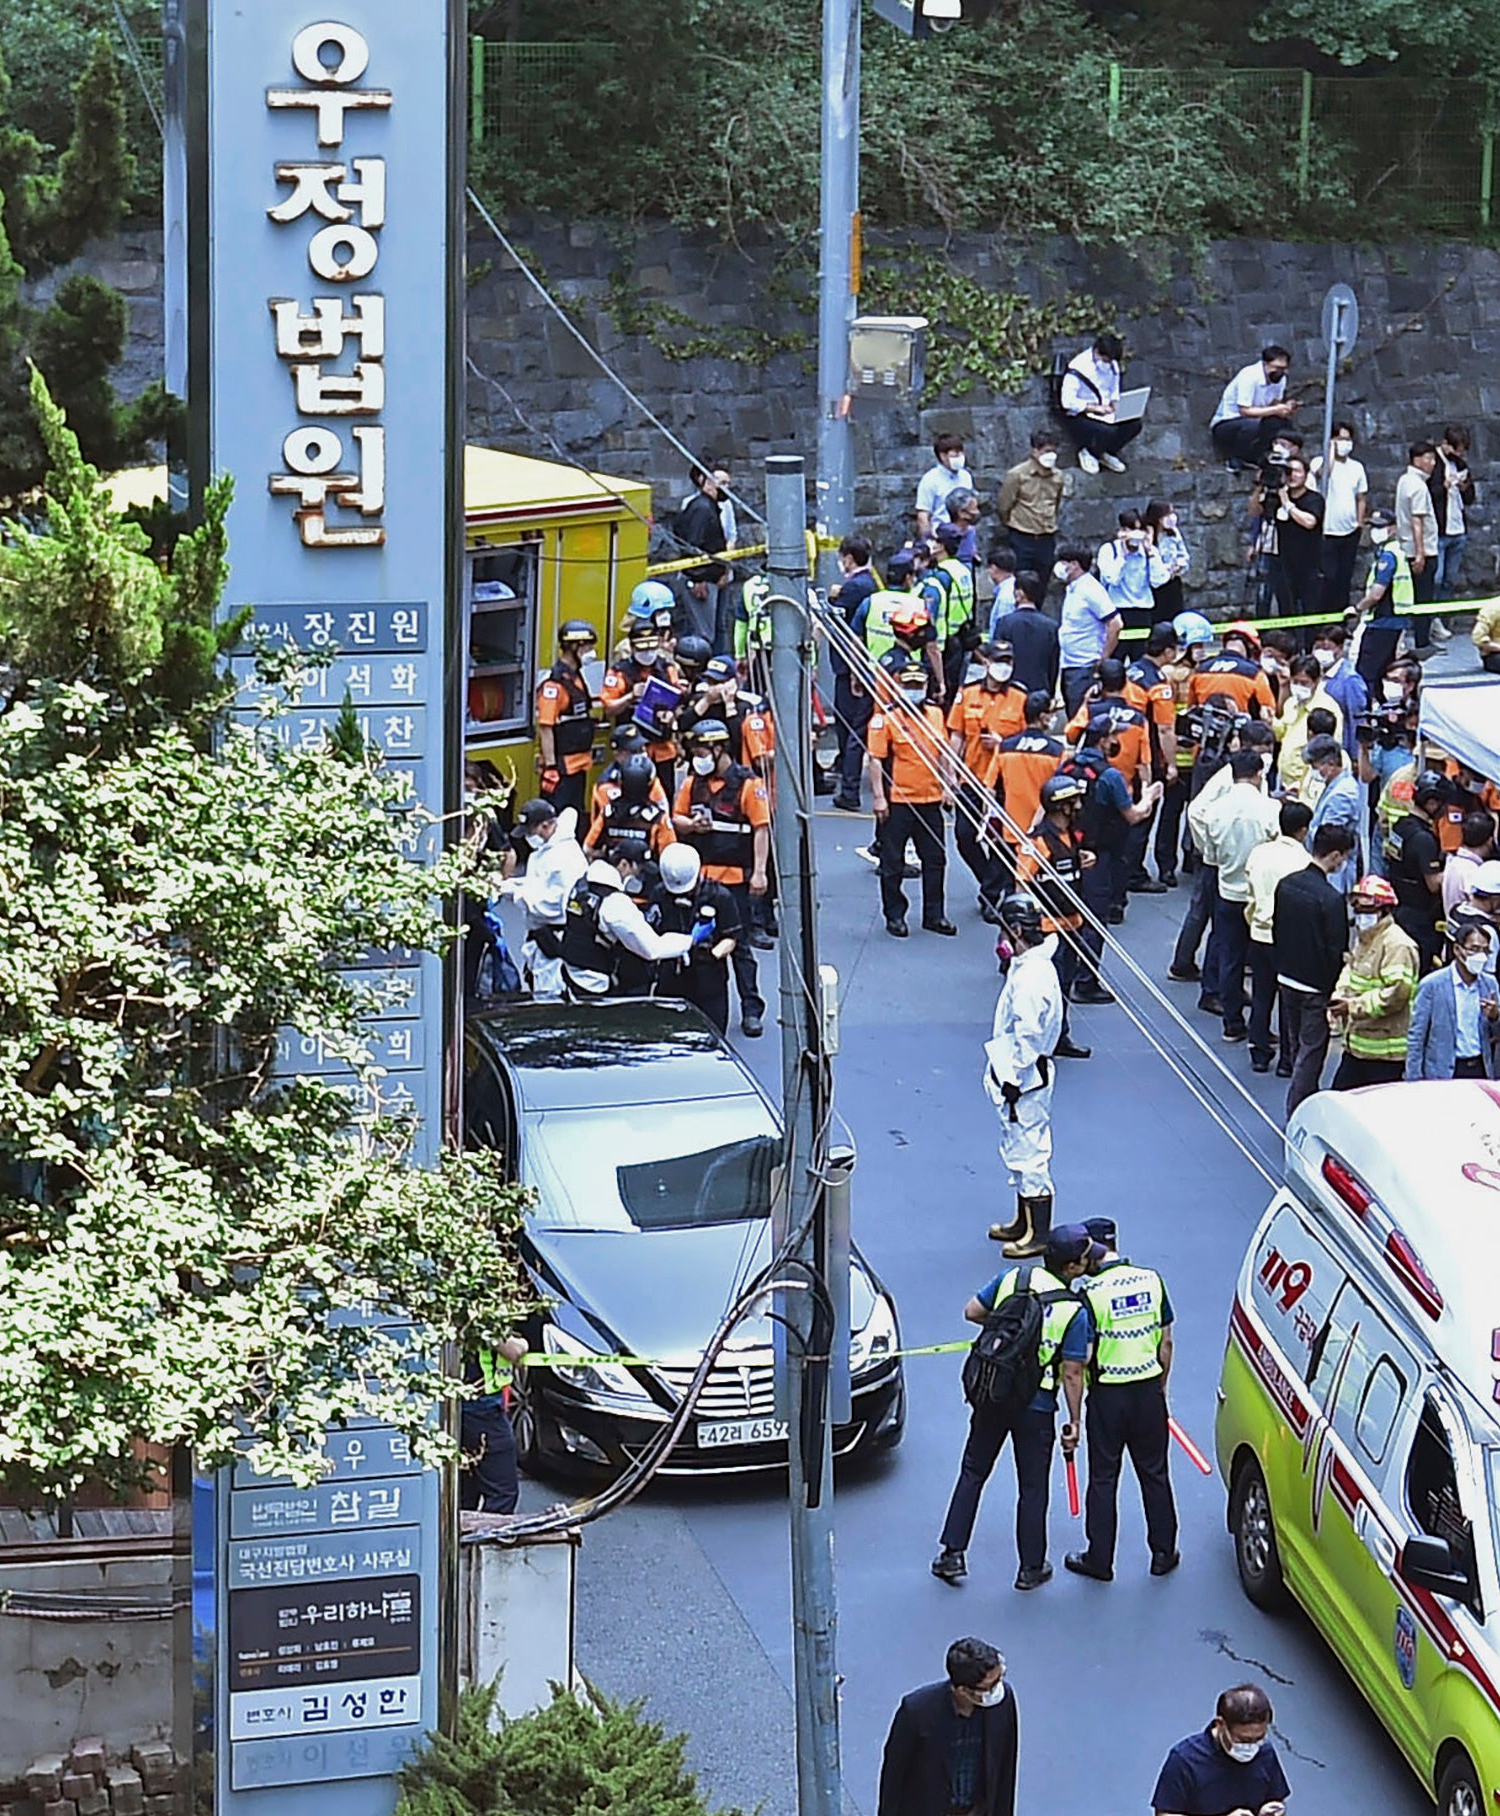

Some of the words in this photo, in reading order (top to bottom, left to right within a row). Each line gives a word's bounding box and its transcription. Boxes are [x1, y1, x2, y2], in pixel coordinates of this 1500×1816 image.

[265, 20, 393, 547] 우정법원
[303, 610, 419, 646] 장진원
[300, 1028, 412, 1065] 이희
[1257, 1246, 1313, 1316] 119
[330, 1487, 401, 1525] 참길
[238, 1554, 354, 1580] 국선전담변호사
[362, 1548, 411, 1570] 사무실
[302, 1688, 408, 1723] 김성한
